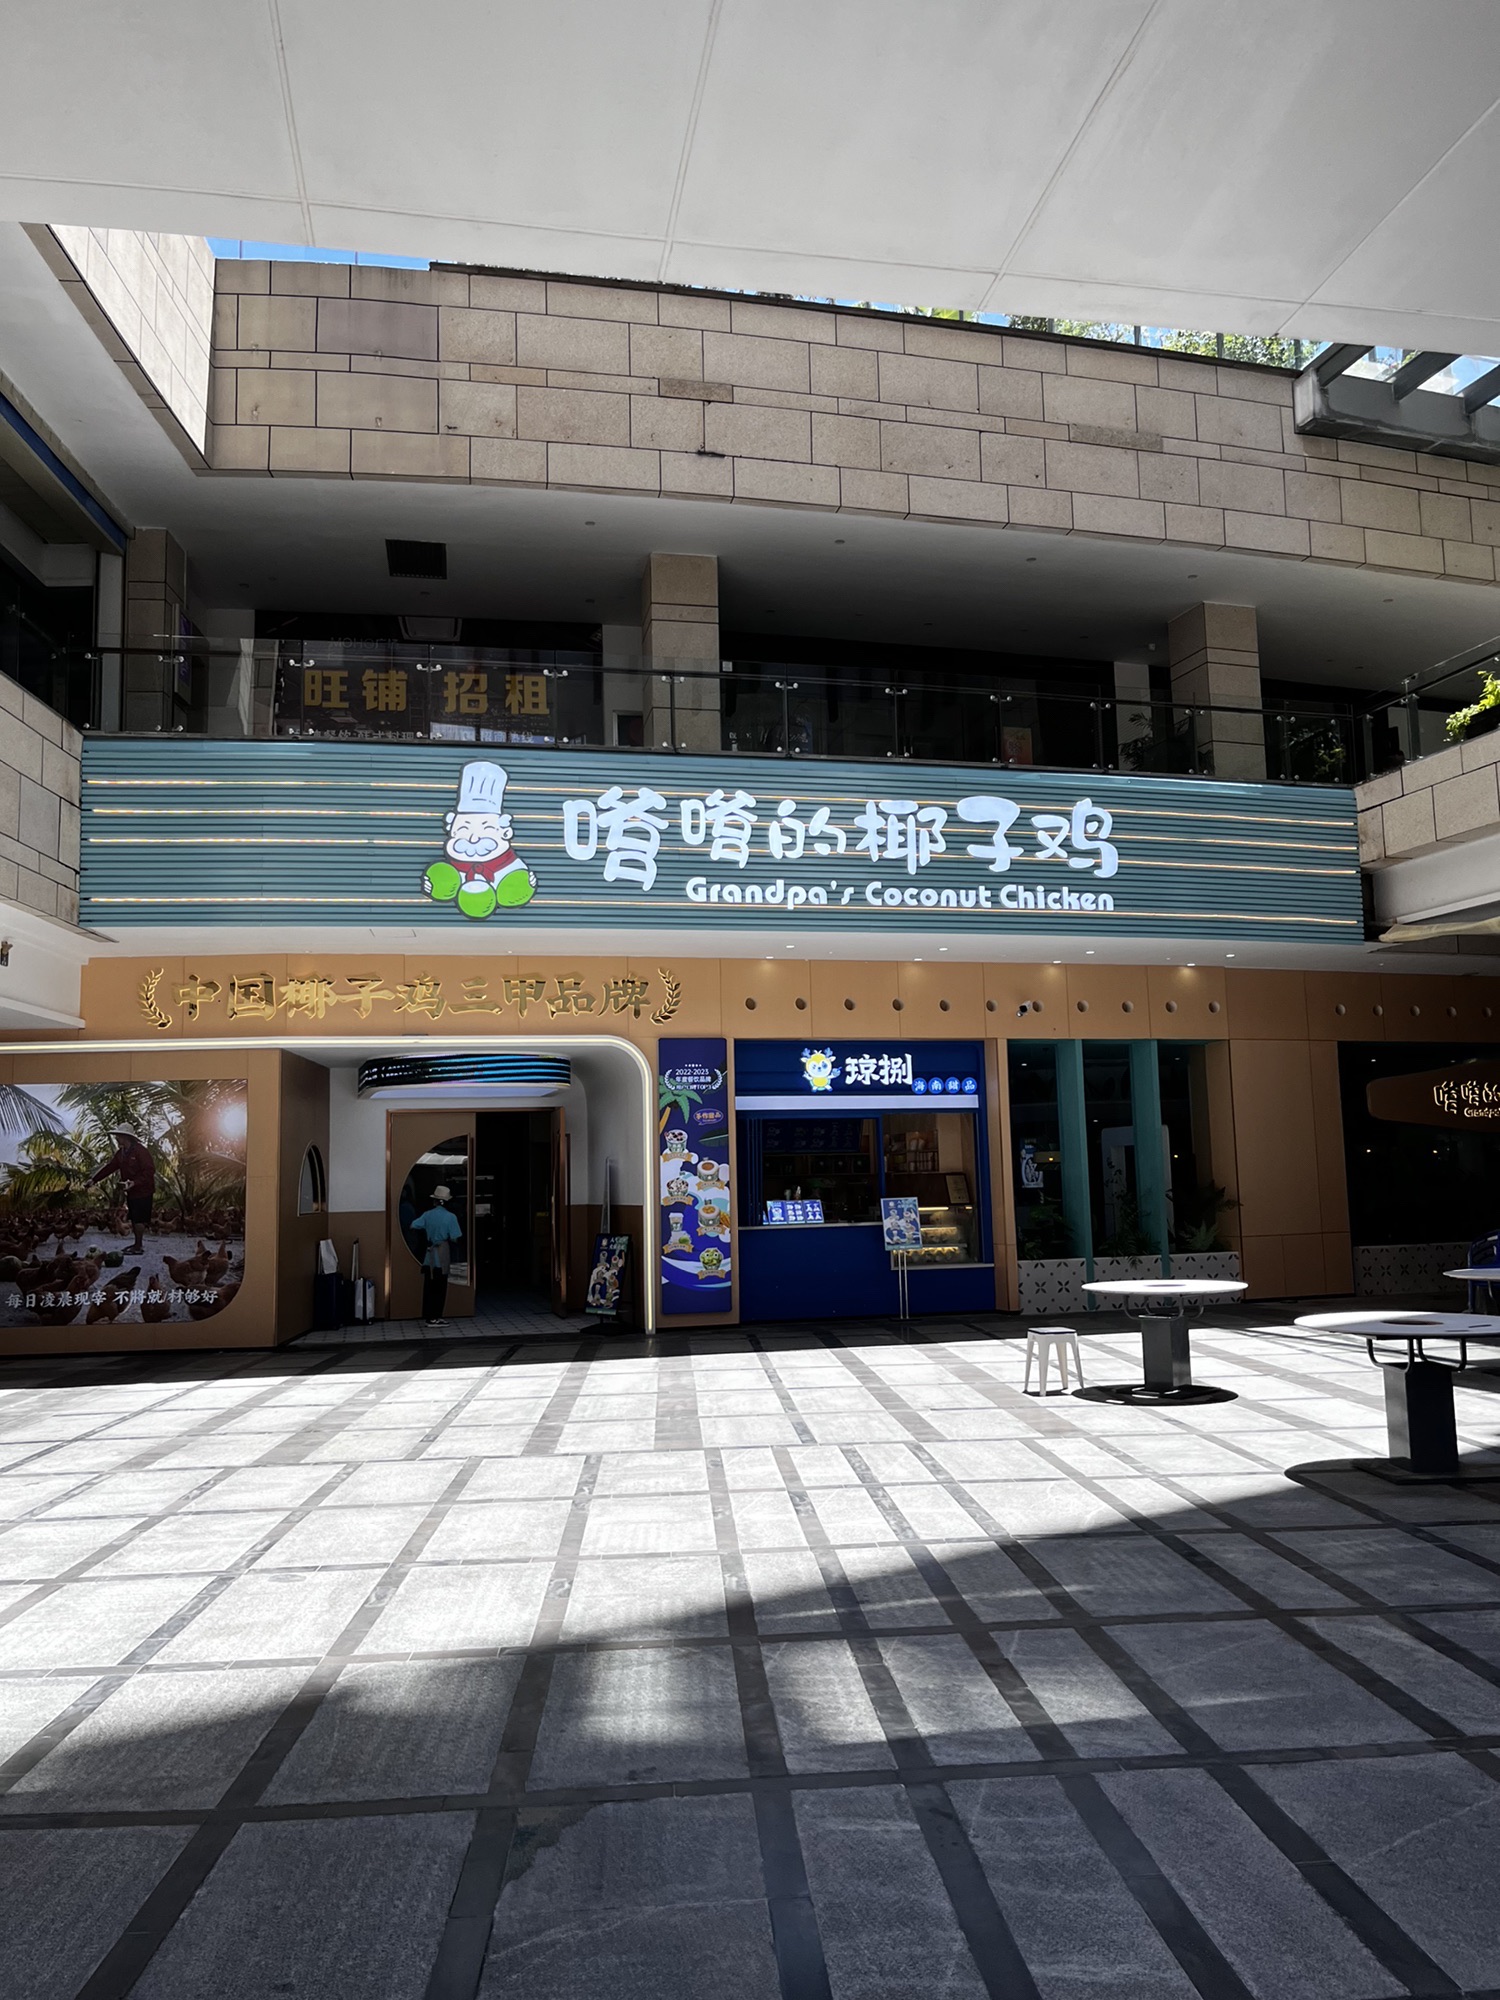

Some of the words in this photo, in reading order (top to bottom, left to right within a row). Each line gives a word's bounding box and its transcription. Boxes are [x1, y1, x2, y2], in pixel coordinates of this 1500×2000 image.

[303, 667, 551, 716] 旺铺招租
[563, 786, 1119, 892] 嗲嗲的椰子鸡
[686, 876, 855, 910] Grandpa's
[865, 880, 992, 908] Coconut
[1000, 883, 1115, 912] Chicken
[171, 972, 652, 1021] 中国椰子鸡三甲品牌
[845, 1053, 913, 1086] 琼捌
[913, 1079, 977, 1092] 海南甜品
[5, 1290, 107, 1309] 每日凌晨现宰
